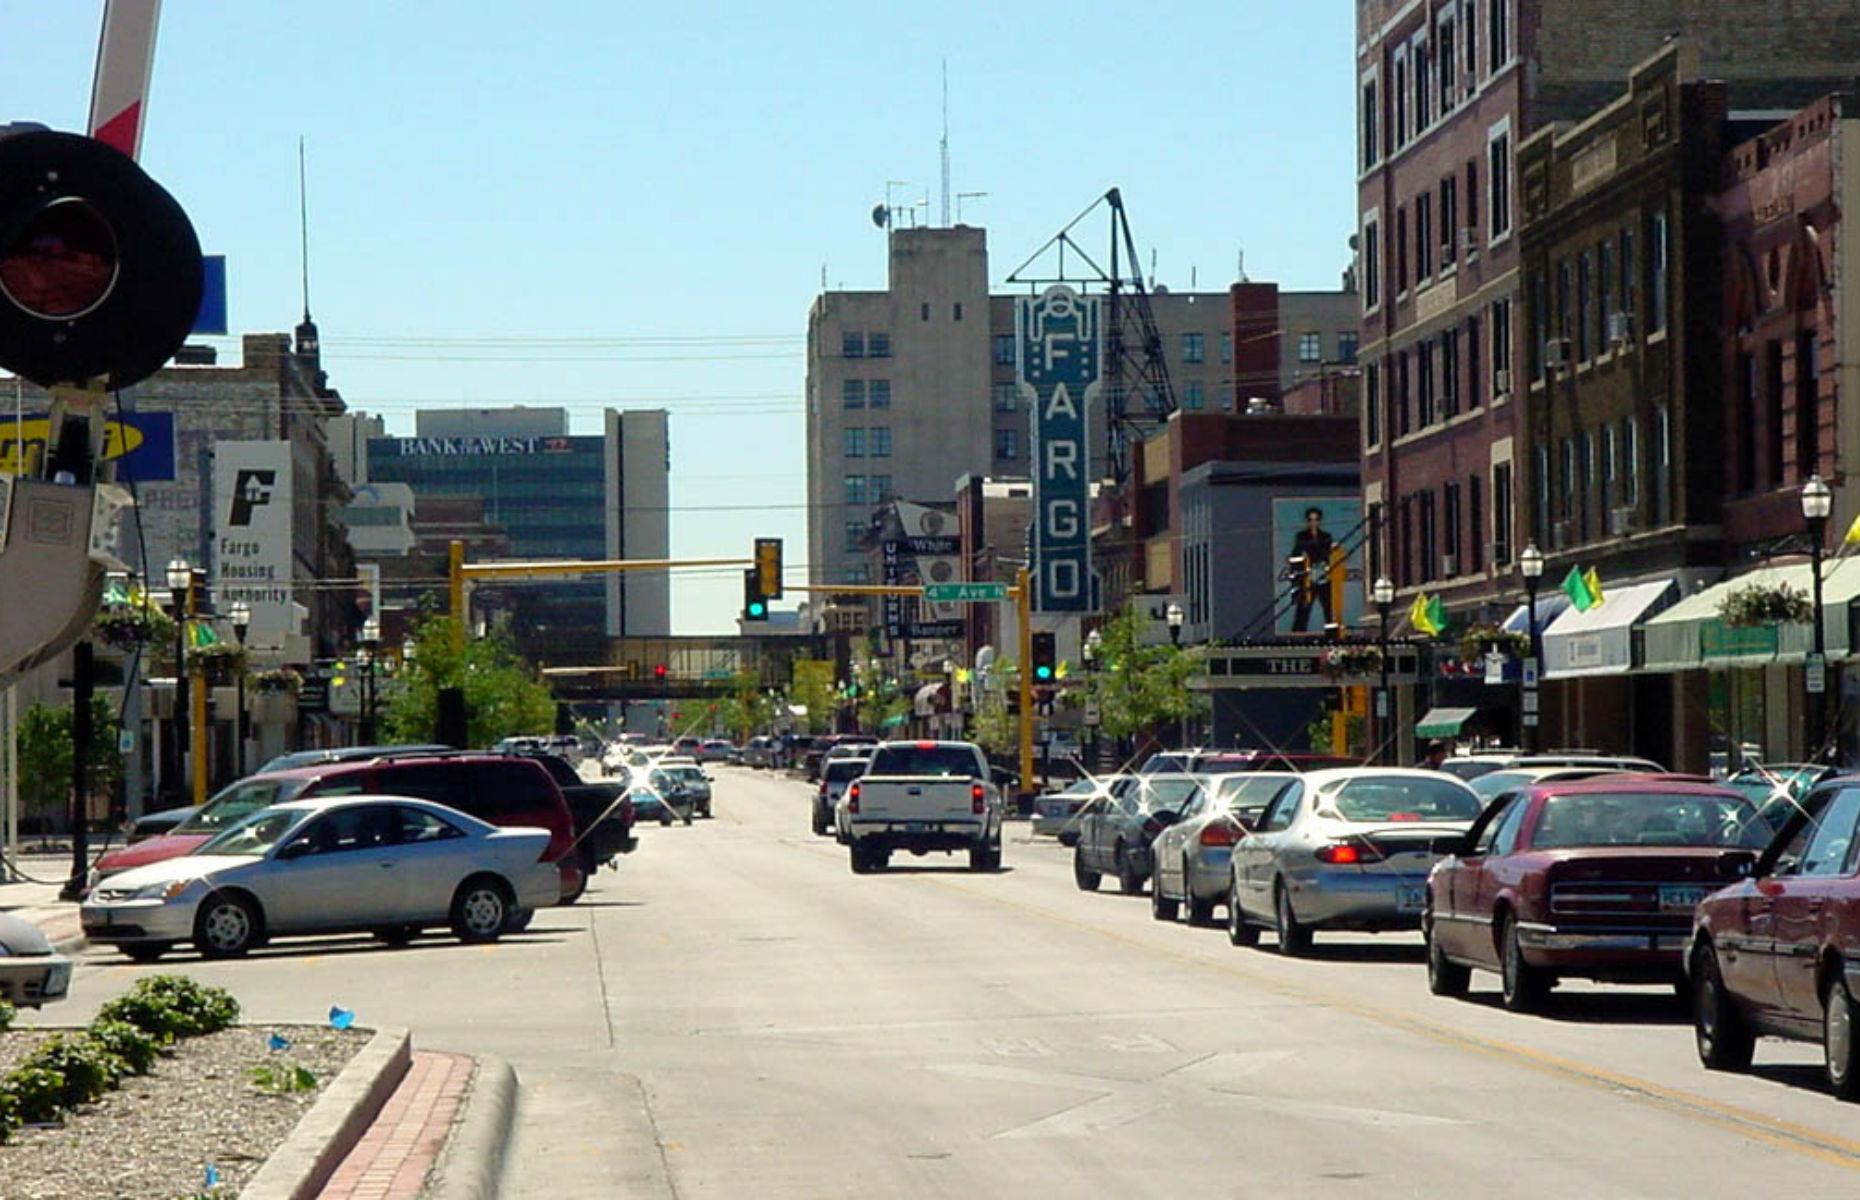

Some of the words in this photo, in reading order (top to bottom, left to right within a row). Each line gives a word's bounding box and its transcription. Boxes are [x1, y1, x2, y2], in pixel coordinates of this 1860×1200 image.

[401, 437, 458, 456] BANK
[480, 437, 539, 456] WEST
[1045, 332, 1080, 598] FARGO
[220, 537, 260, 557] Fargo
[220, 561, 275, 580] Housing
[221, 587, 287, 605] Authority
[958, 586, 987, 599] Ave
[994, 586, 1004, 597] N
[1267, 658, 1312, 674] THE
